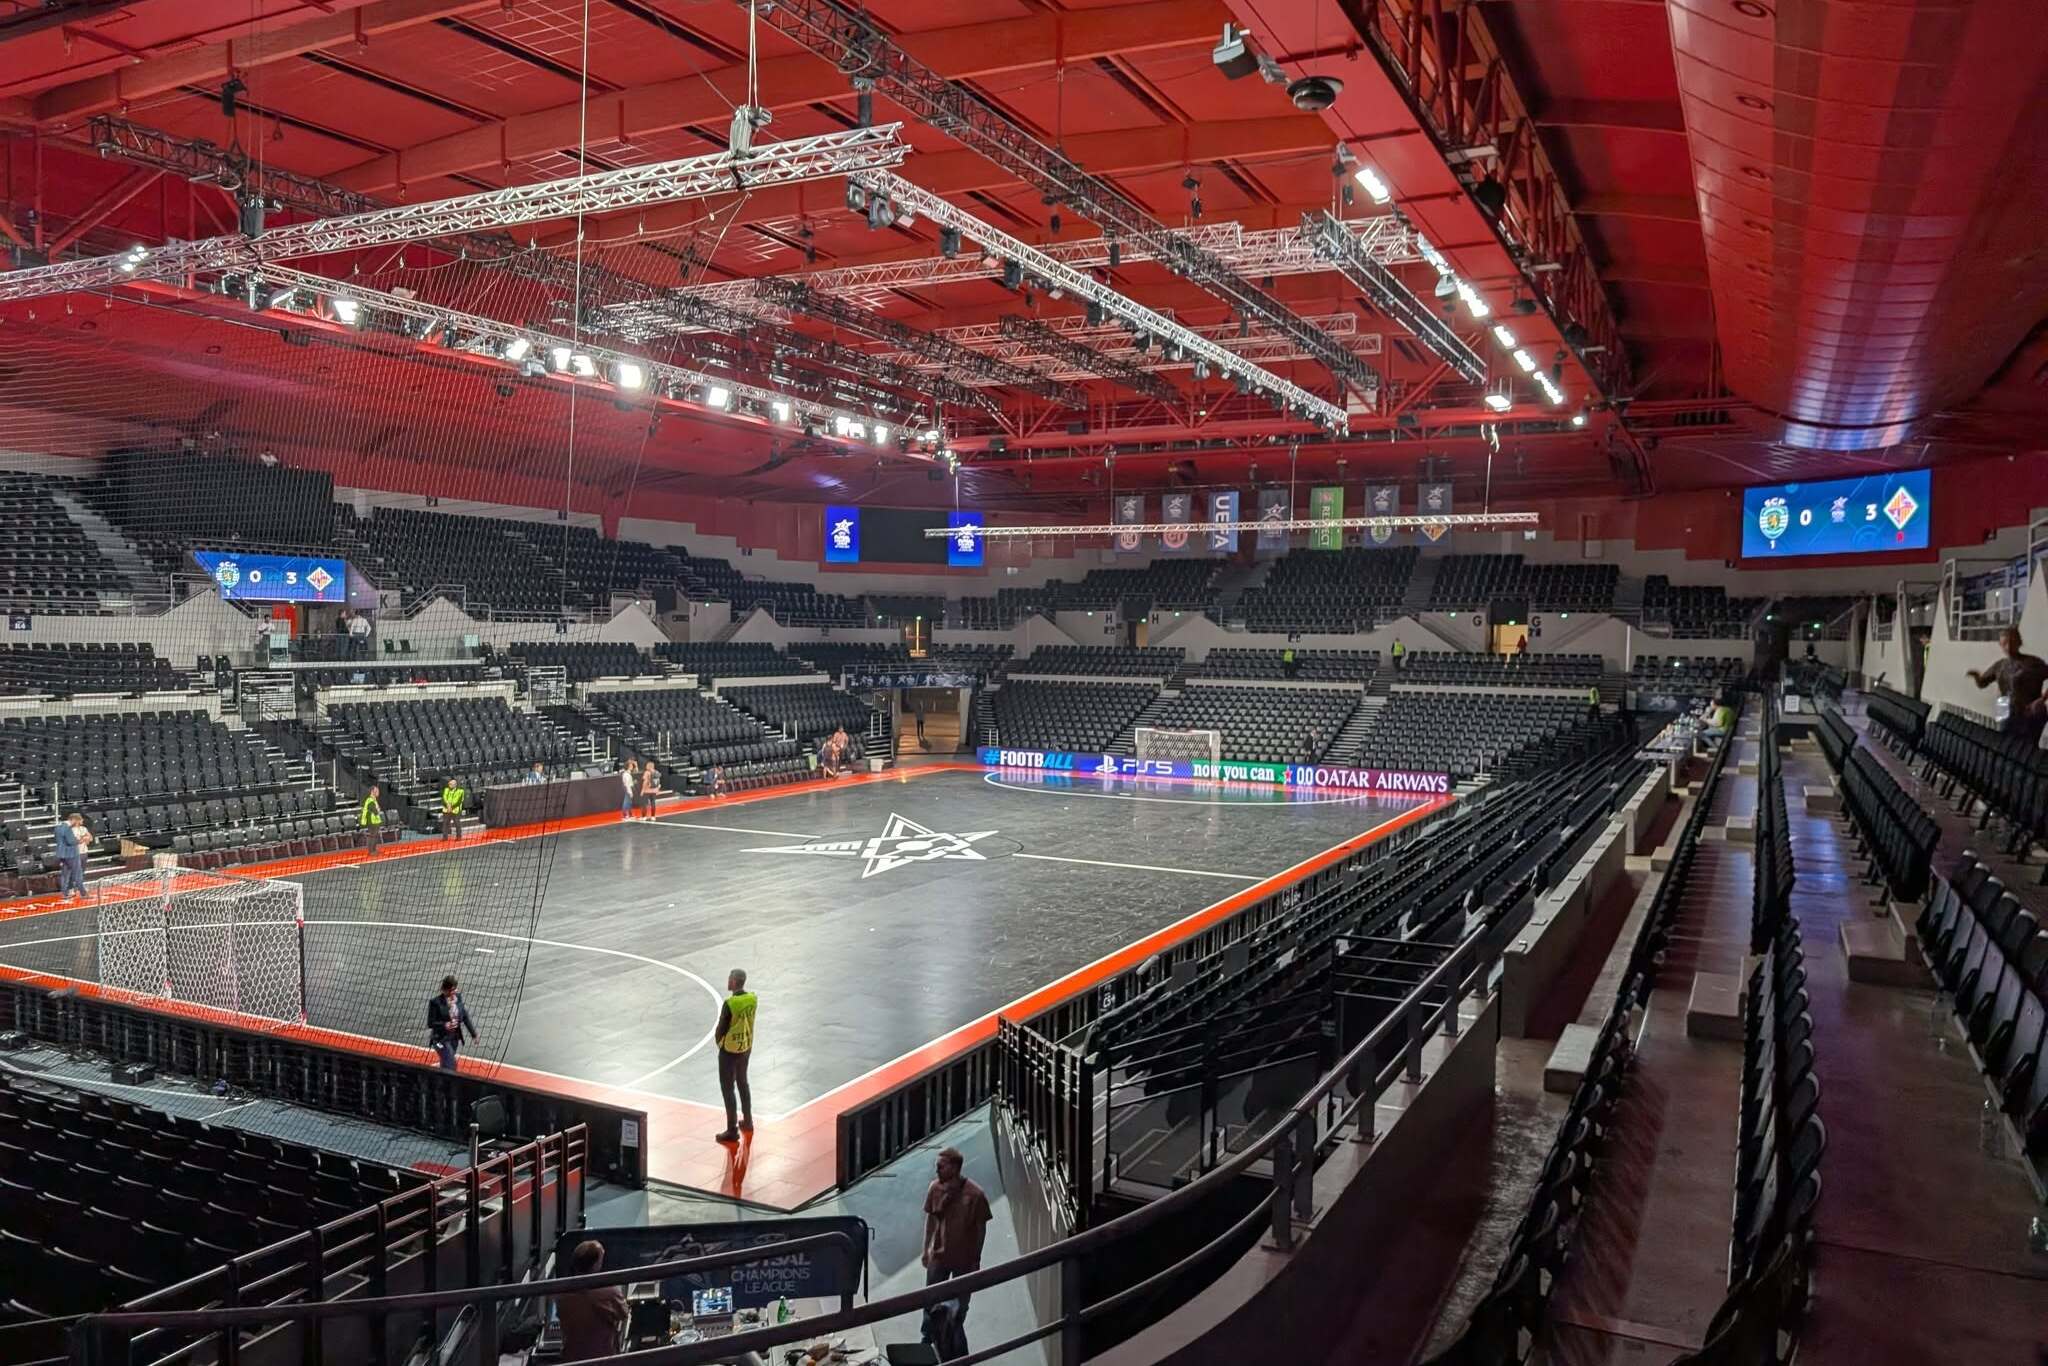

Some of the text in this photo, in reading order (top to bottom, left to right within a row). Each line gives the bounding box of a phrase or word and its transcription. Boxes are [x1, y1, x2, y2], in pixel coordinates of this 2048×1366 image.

[1800, 509, 1812, 526] 0
[1865, 503, 1877, 521] 3
[249, 570, 297, 584] 0 3
[1105, 613, 1113, 624] H
[1152, 613, 1159, 625] H
[1472, 615, 1482, 627] G
[1532, 616, 1542, 627] G
[984, 749, 1073, 770] #FOOTBALL
[1122, 758, 1173, 774] PS5
[1193, 762, 1275, 781] now you can
[1315, 767, 1448, 793] QATAR AIRWAYS
[731, 1267, 809, 1282] CHAMPIONS
[744, 1280, 797, 1294] LEAGUE
